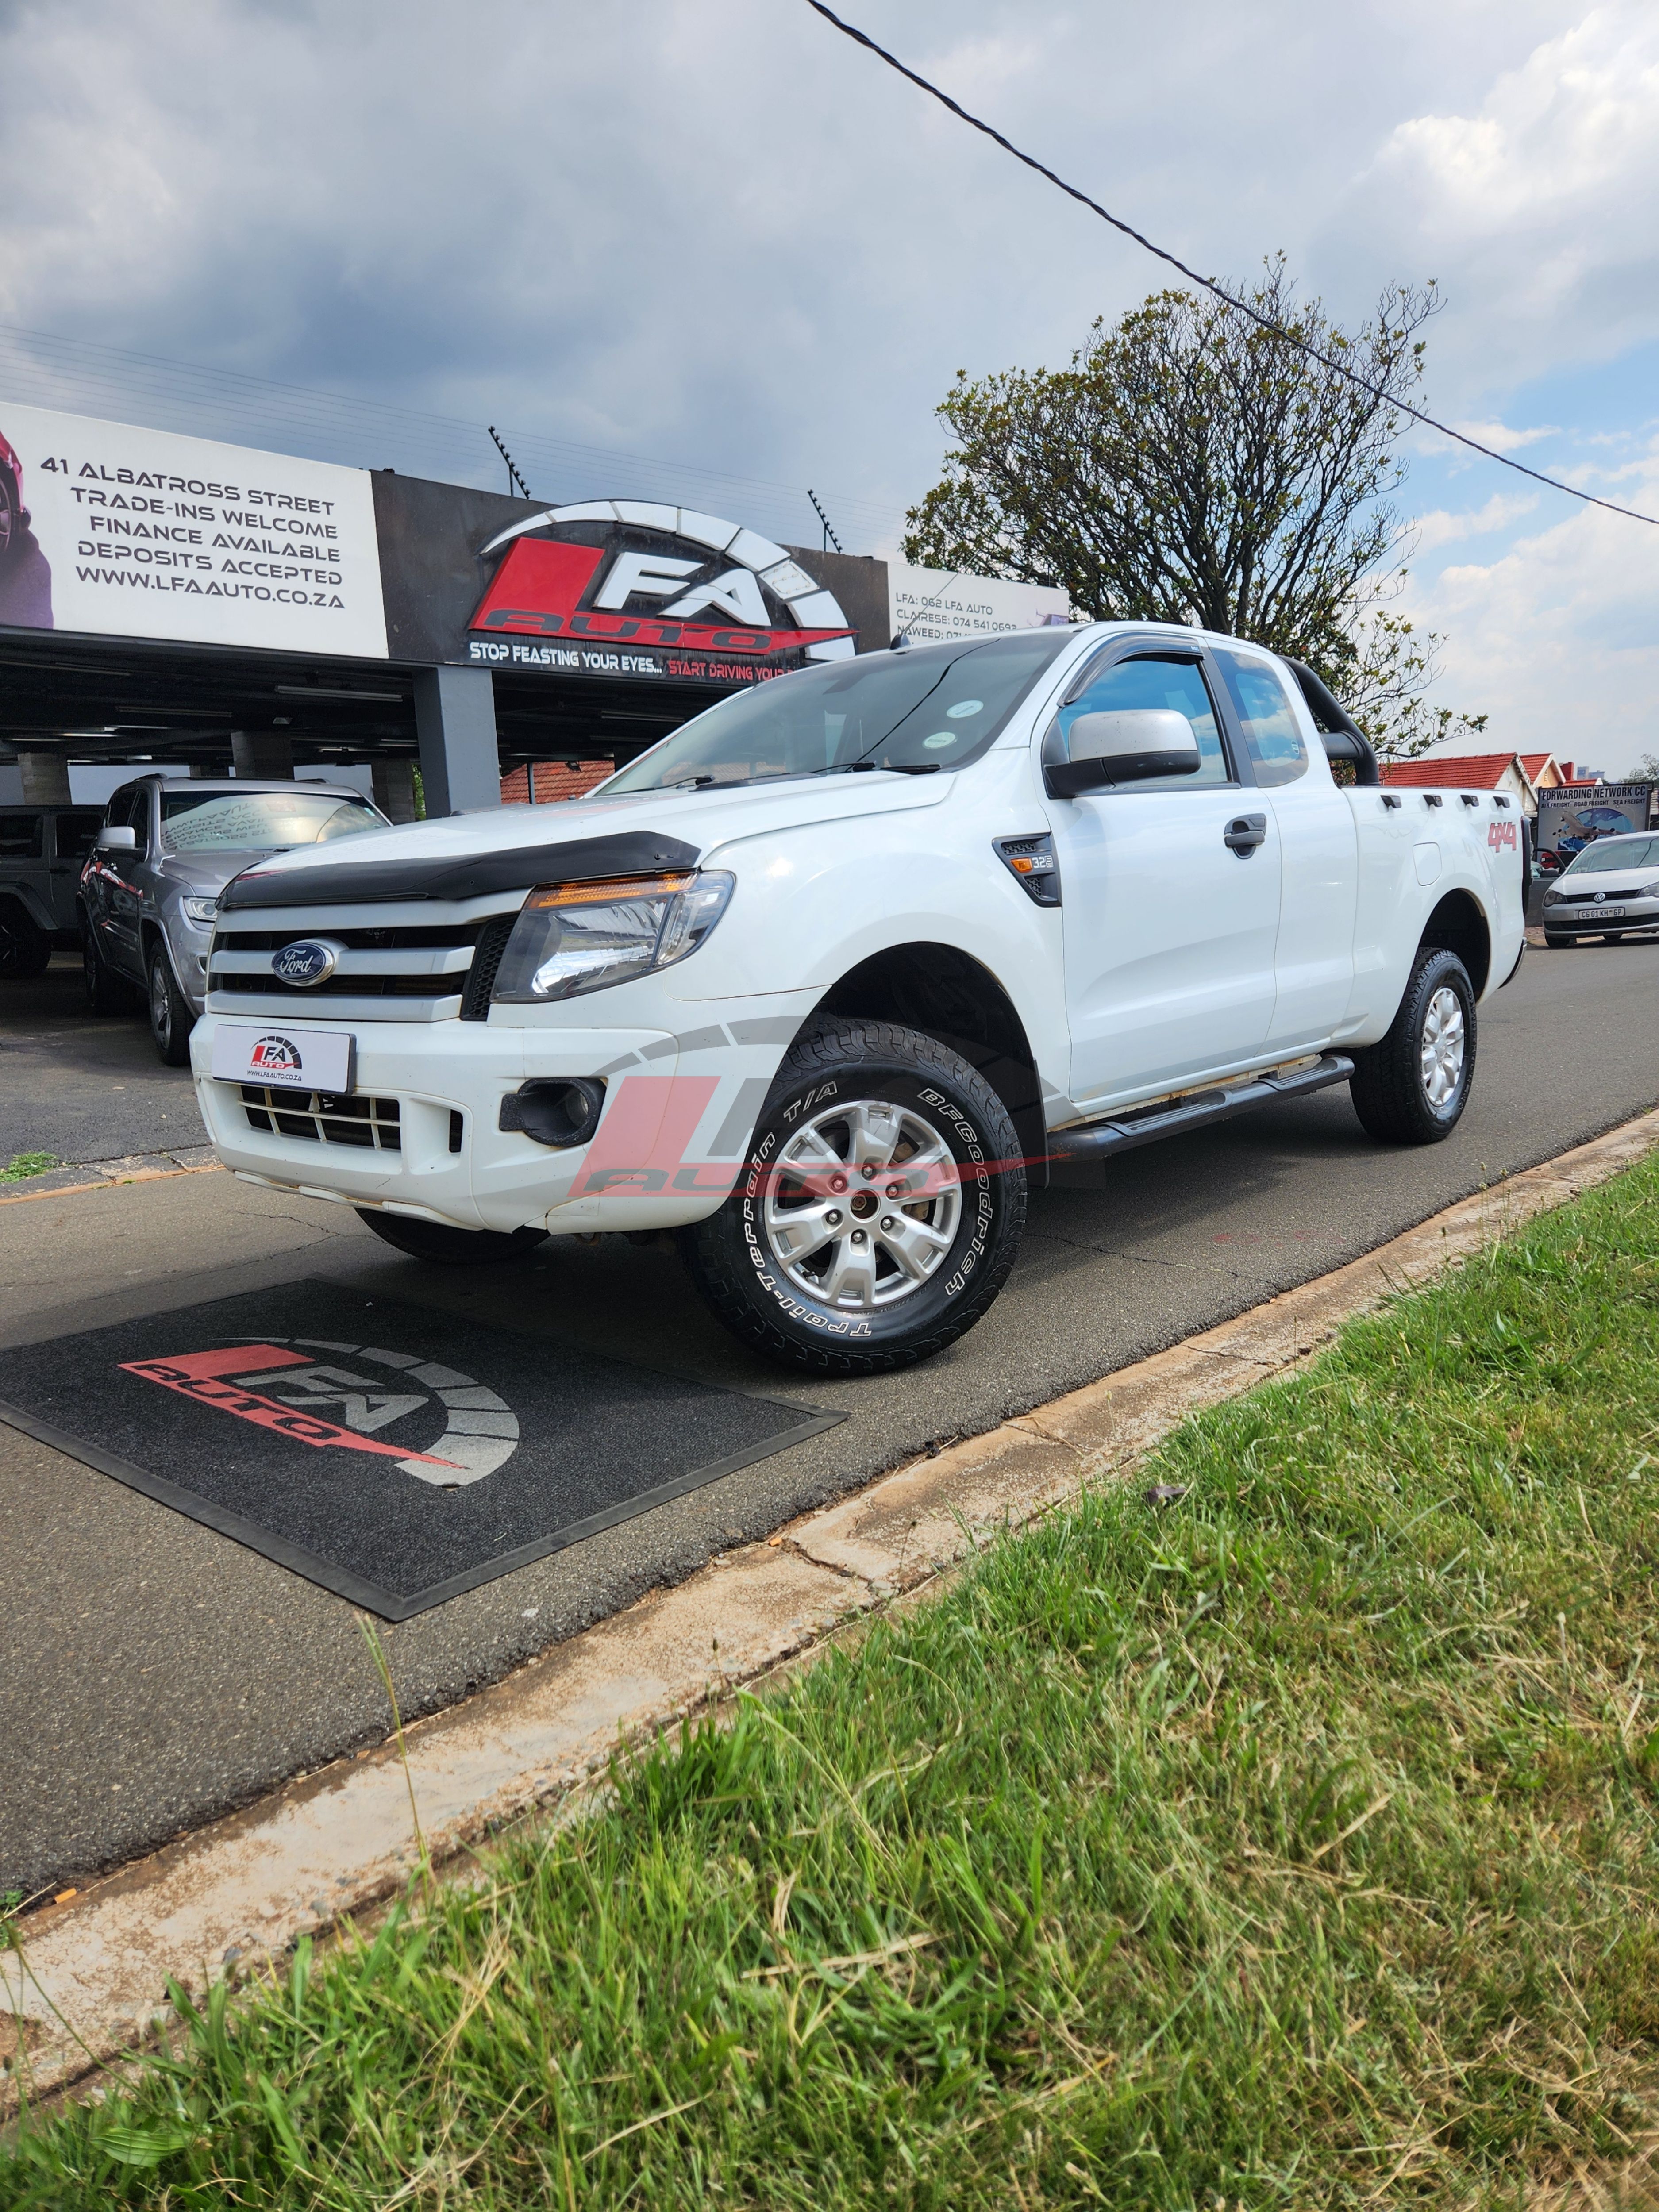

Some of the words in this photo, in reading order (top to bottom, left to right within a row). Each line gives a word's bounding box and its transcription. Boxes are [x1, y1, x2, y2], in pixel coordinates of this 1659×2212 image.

[41, 457, 69, 474] 41
[79, 463, 241, 500] ALBATROSS
[248, 490, 335, 515] STREET
[70, 487, 216, 521] TRADE-INS
[222, 510, 338, 539] WELCOME
[90, 516, 203, 544] FINANCE
[212, 533, 340, 562] AVAILABLE
[78, 541, 212, 570] DEPOSITS
[221, 559, 342, 585] ACCEPTED
[76, 566, 345, 608] WWW.LFAAUTO.CO.ZA
[896, 593, 918, 605] LFA:
[921, 597, 942, 608] 062
[945, 600, 963, 611] LFA
[966, 604, 993, 615] AUTO
[484, 609, 771, 650] AUTO
[898, 625, 943, 639] NAWEED:
[953, 617, 970, 627] 074
[974, 619, 989, 630] 541
[470, 642, 509, 660] STOP
[512, 645, 579, 666] FEASTING
[582, 652, 619, 670] YOUR
[622, 655, 662, 674] EYES...
[669, 660, 706, 676] START
[709, 664, 752, 680] DRIVING
[1542, 789, 1592, 800] FORWARDING
[1594, 787, 1632, 798] NETWORK
[1635, 785, 1645, 796] CC
[279, 949, 313, 973] Ford
[251, 1045, 286, 1063] LFA
[247, 1070, 302, 1081] WWW.LFAAUTO.CO.ZA
[784, 1081, 838, 1123] T/A
[917, 1088, 993, 1296] BFGoodrich
[743, 1132, 872, 1337] Trail-Terrain
[132, 1363, 342, 1440] AUTO
